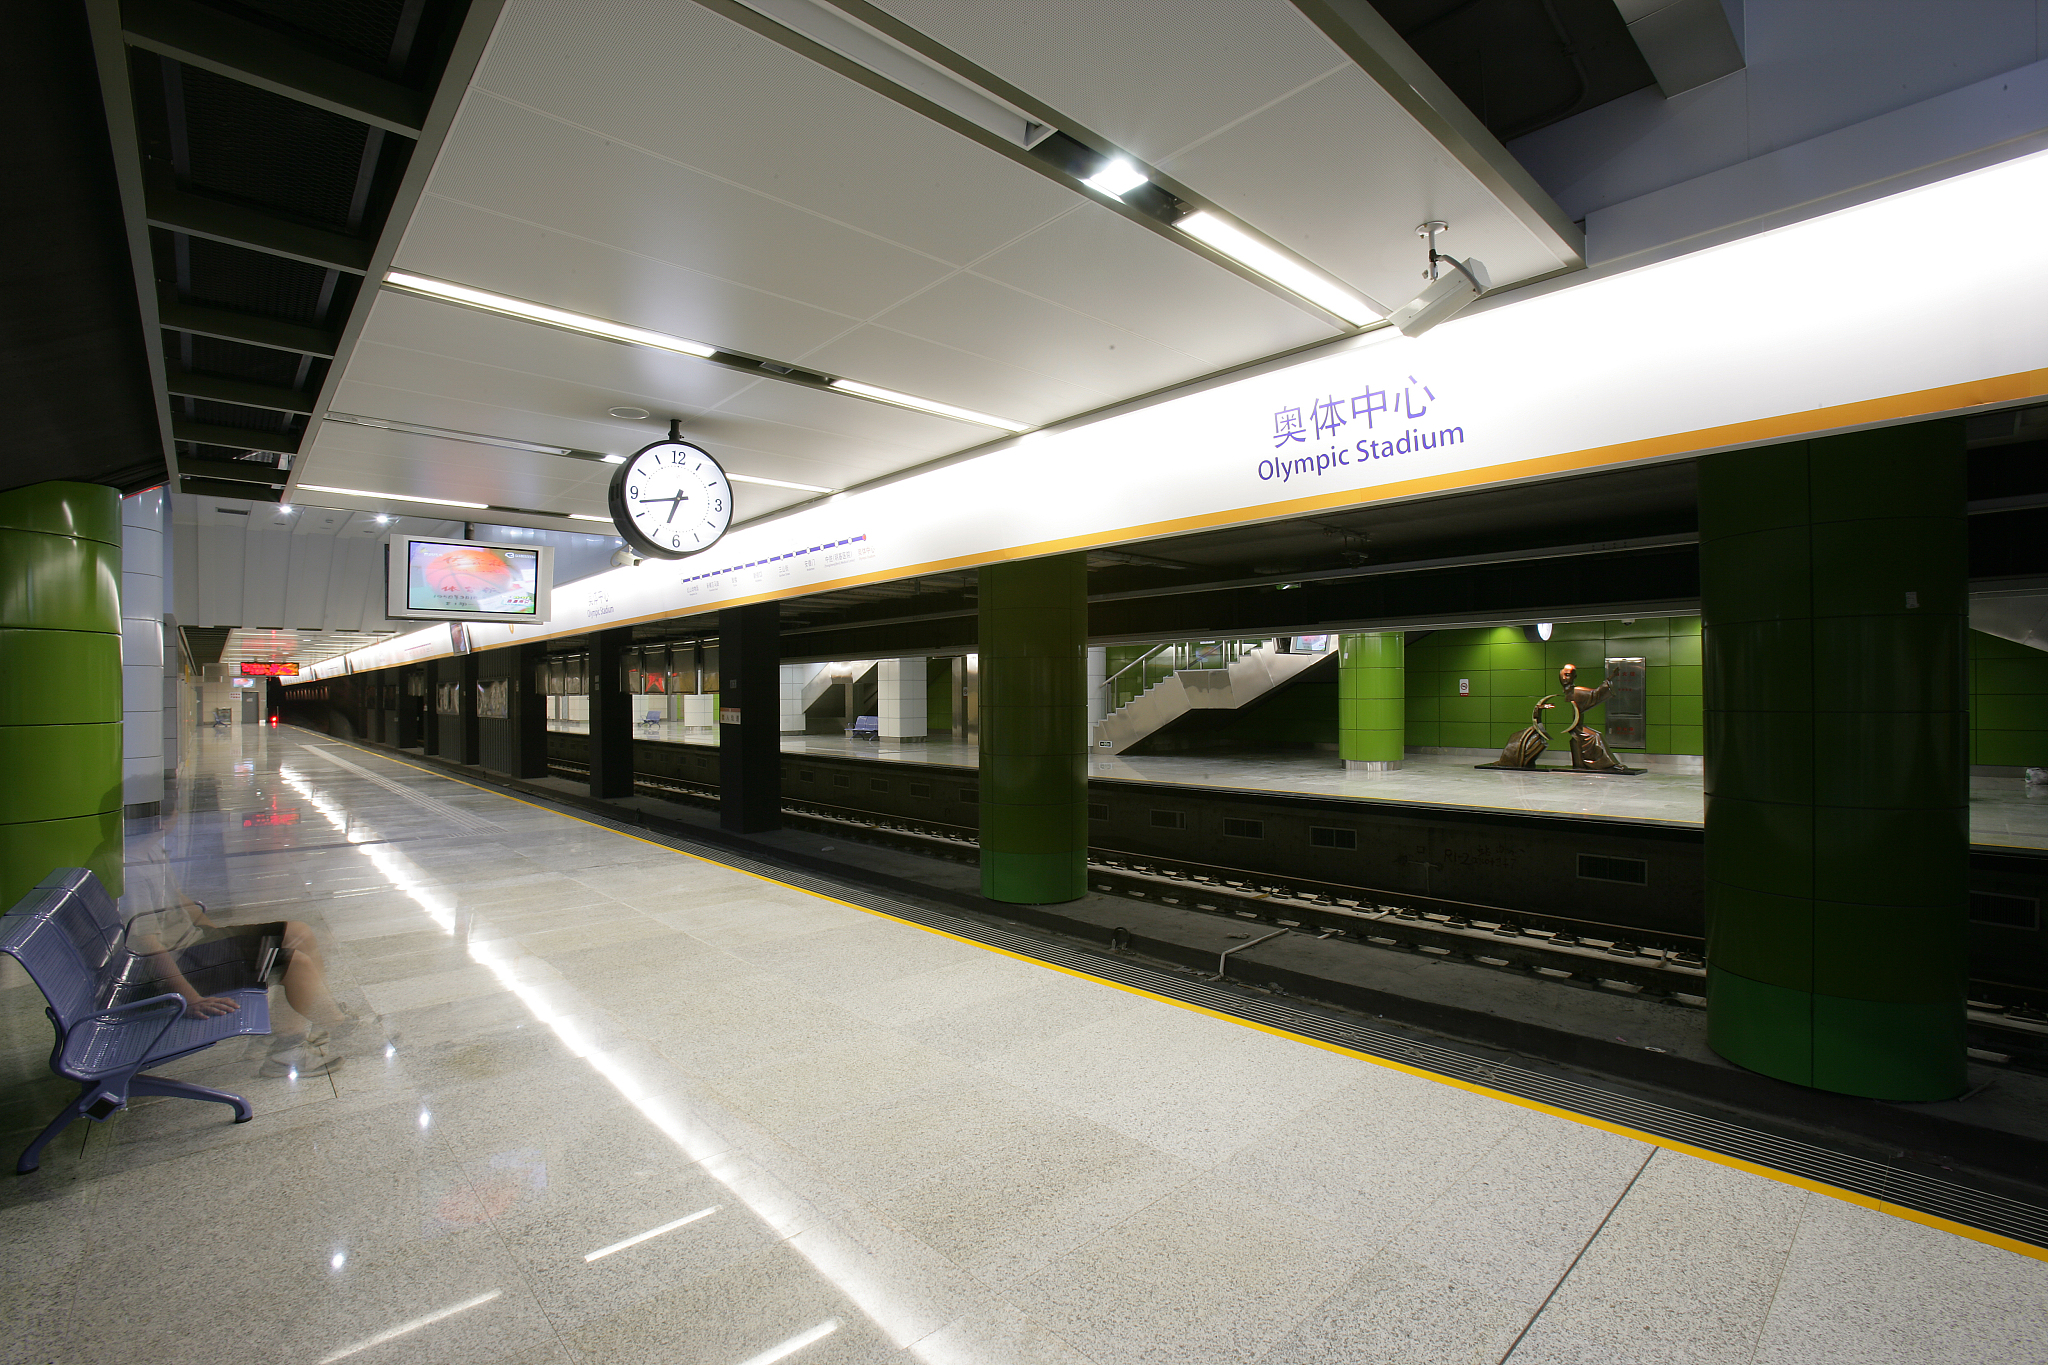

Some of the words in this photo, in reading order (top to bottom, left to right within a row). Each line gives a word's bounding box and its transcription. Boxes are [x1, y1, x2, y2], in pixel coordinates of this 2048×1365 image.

[1273, 375, 1436, 448] 奥体中心
[671, 450, 686, 466] 12
[1258, 445, 1350, 483] Olympic
[1356, 426, 1465, 463] Stadium
[630, 485, 639, 500] 9
[714, 498, 723, 513] 3
[672, 534, 681, 549] 6
